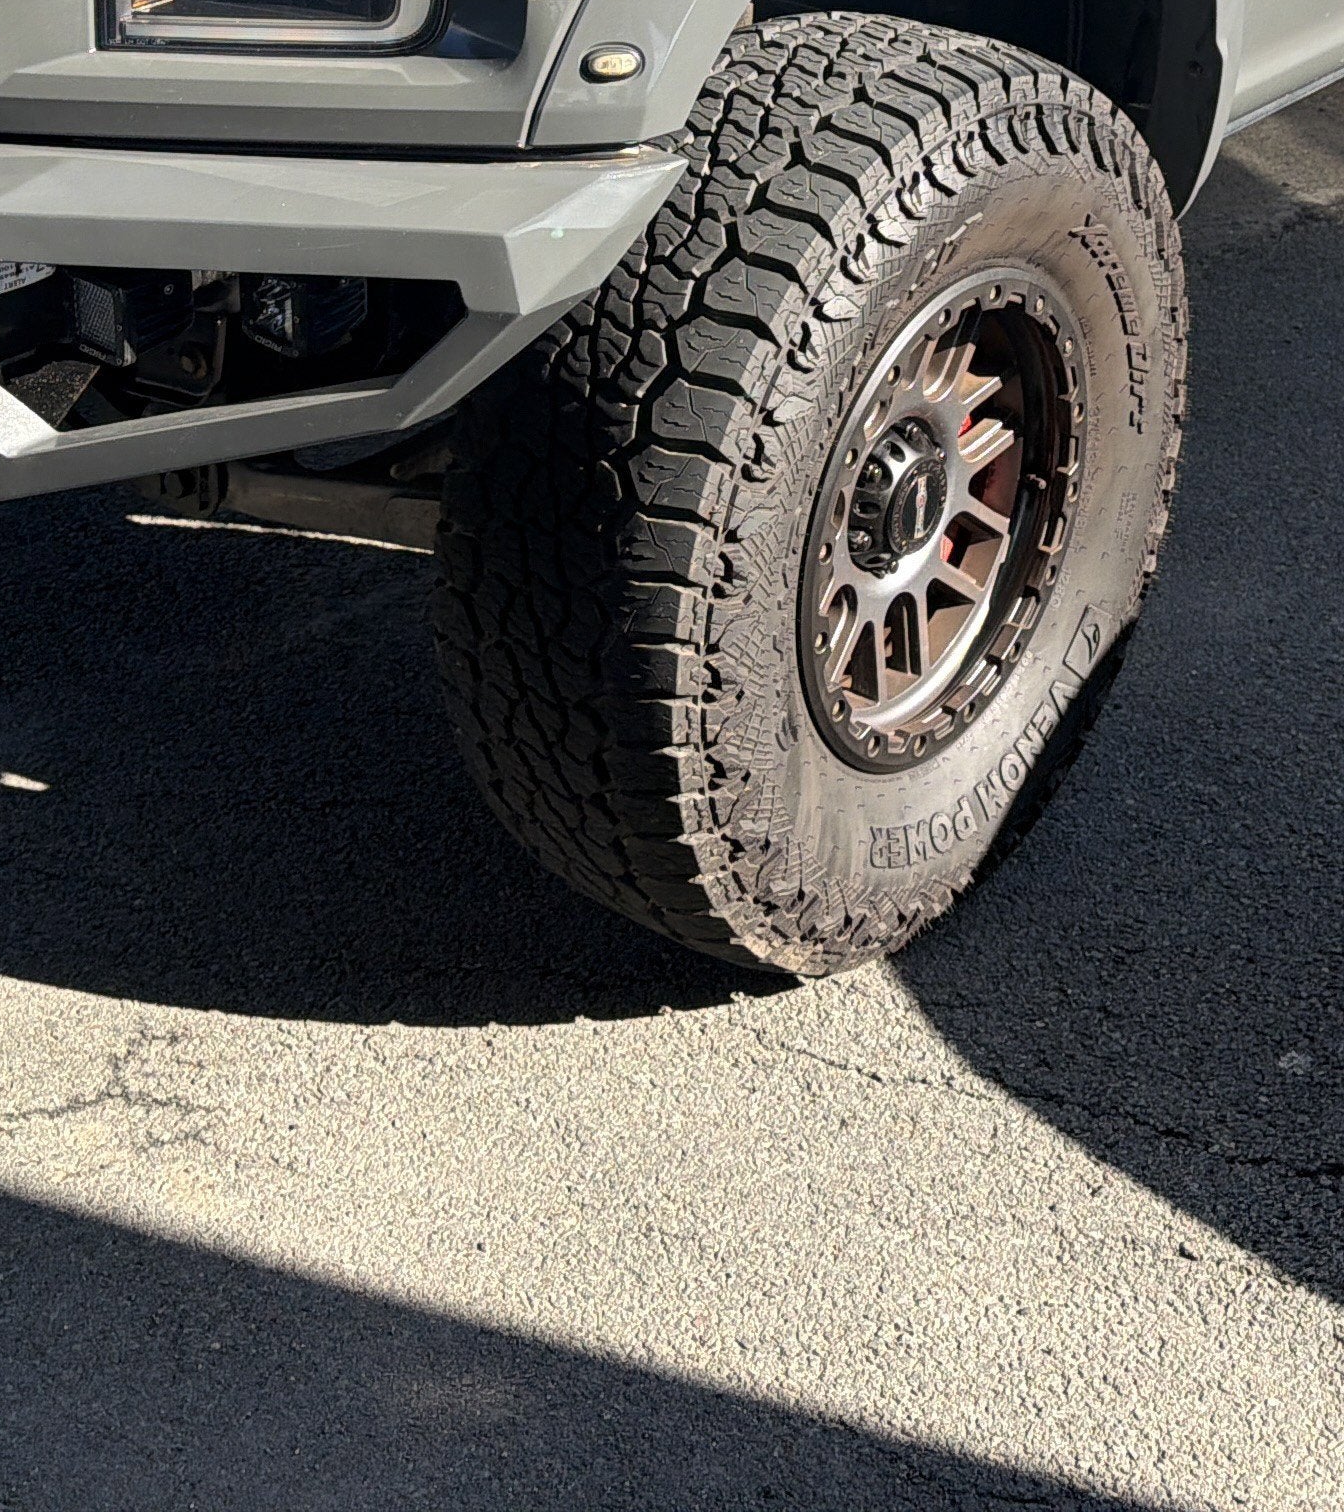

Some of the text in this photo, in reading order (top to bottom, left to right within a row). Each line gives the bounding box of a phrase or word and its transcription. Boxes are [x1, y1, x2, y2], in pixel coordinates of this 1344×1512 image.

[4, 277, 27, 290] ALERT
[255, 334, 283, 352] RIGID
[973, 679, 1080, 822] VENOM
[869, 795, 978, 869] POWER
